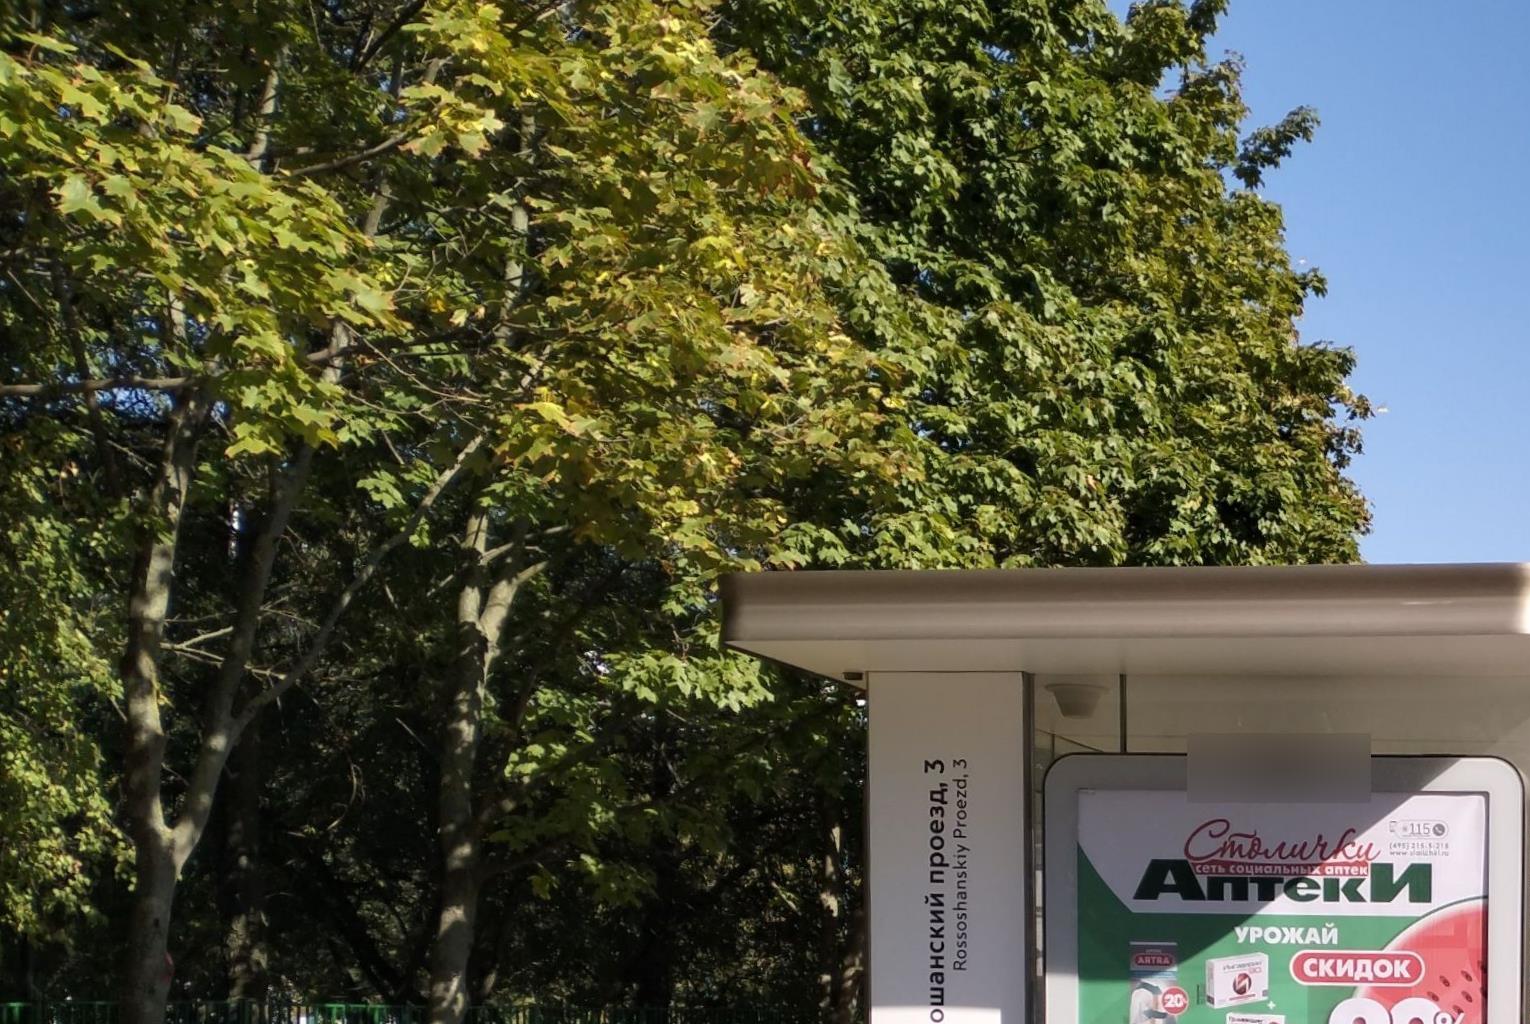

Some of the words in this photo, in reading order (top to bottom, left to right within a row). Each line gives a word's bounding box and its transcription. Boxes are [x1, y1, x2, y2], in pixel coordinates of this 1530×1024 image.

[924, 759, 945, 774] 3
[952, 759, 967, 769] 3
[952, 774, 969, 838] Proezd,
[929, 782, 949, 884] проезд,
[1184, 818, 1381, 862] Столички
[1196, 865, 1225, 875] сеть
[1229, 864, 1321, 877] социальных
[1325, 865, 1369, 876] аптек
[952, 848, 970, 971] Rossoshanskiy
[1234, 922, 1338, 946] УРОЖАЙ
[1303, 958, 1411, 981] СКИДОК
